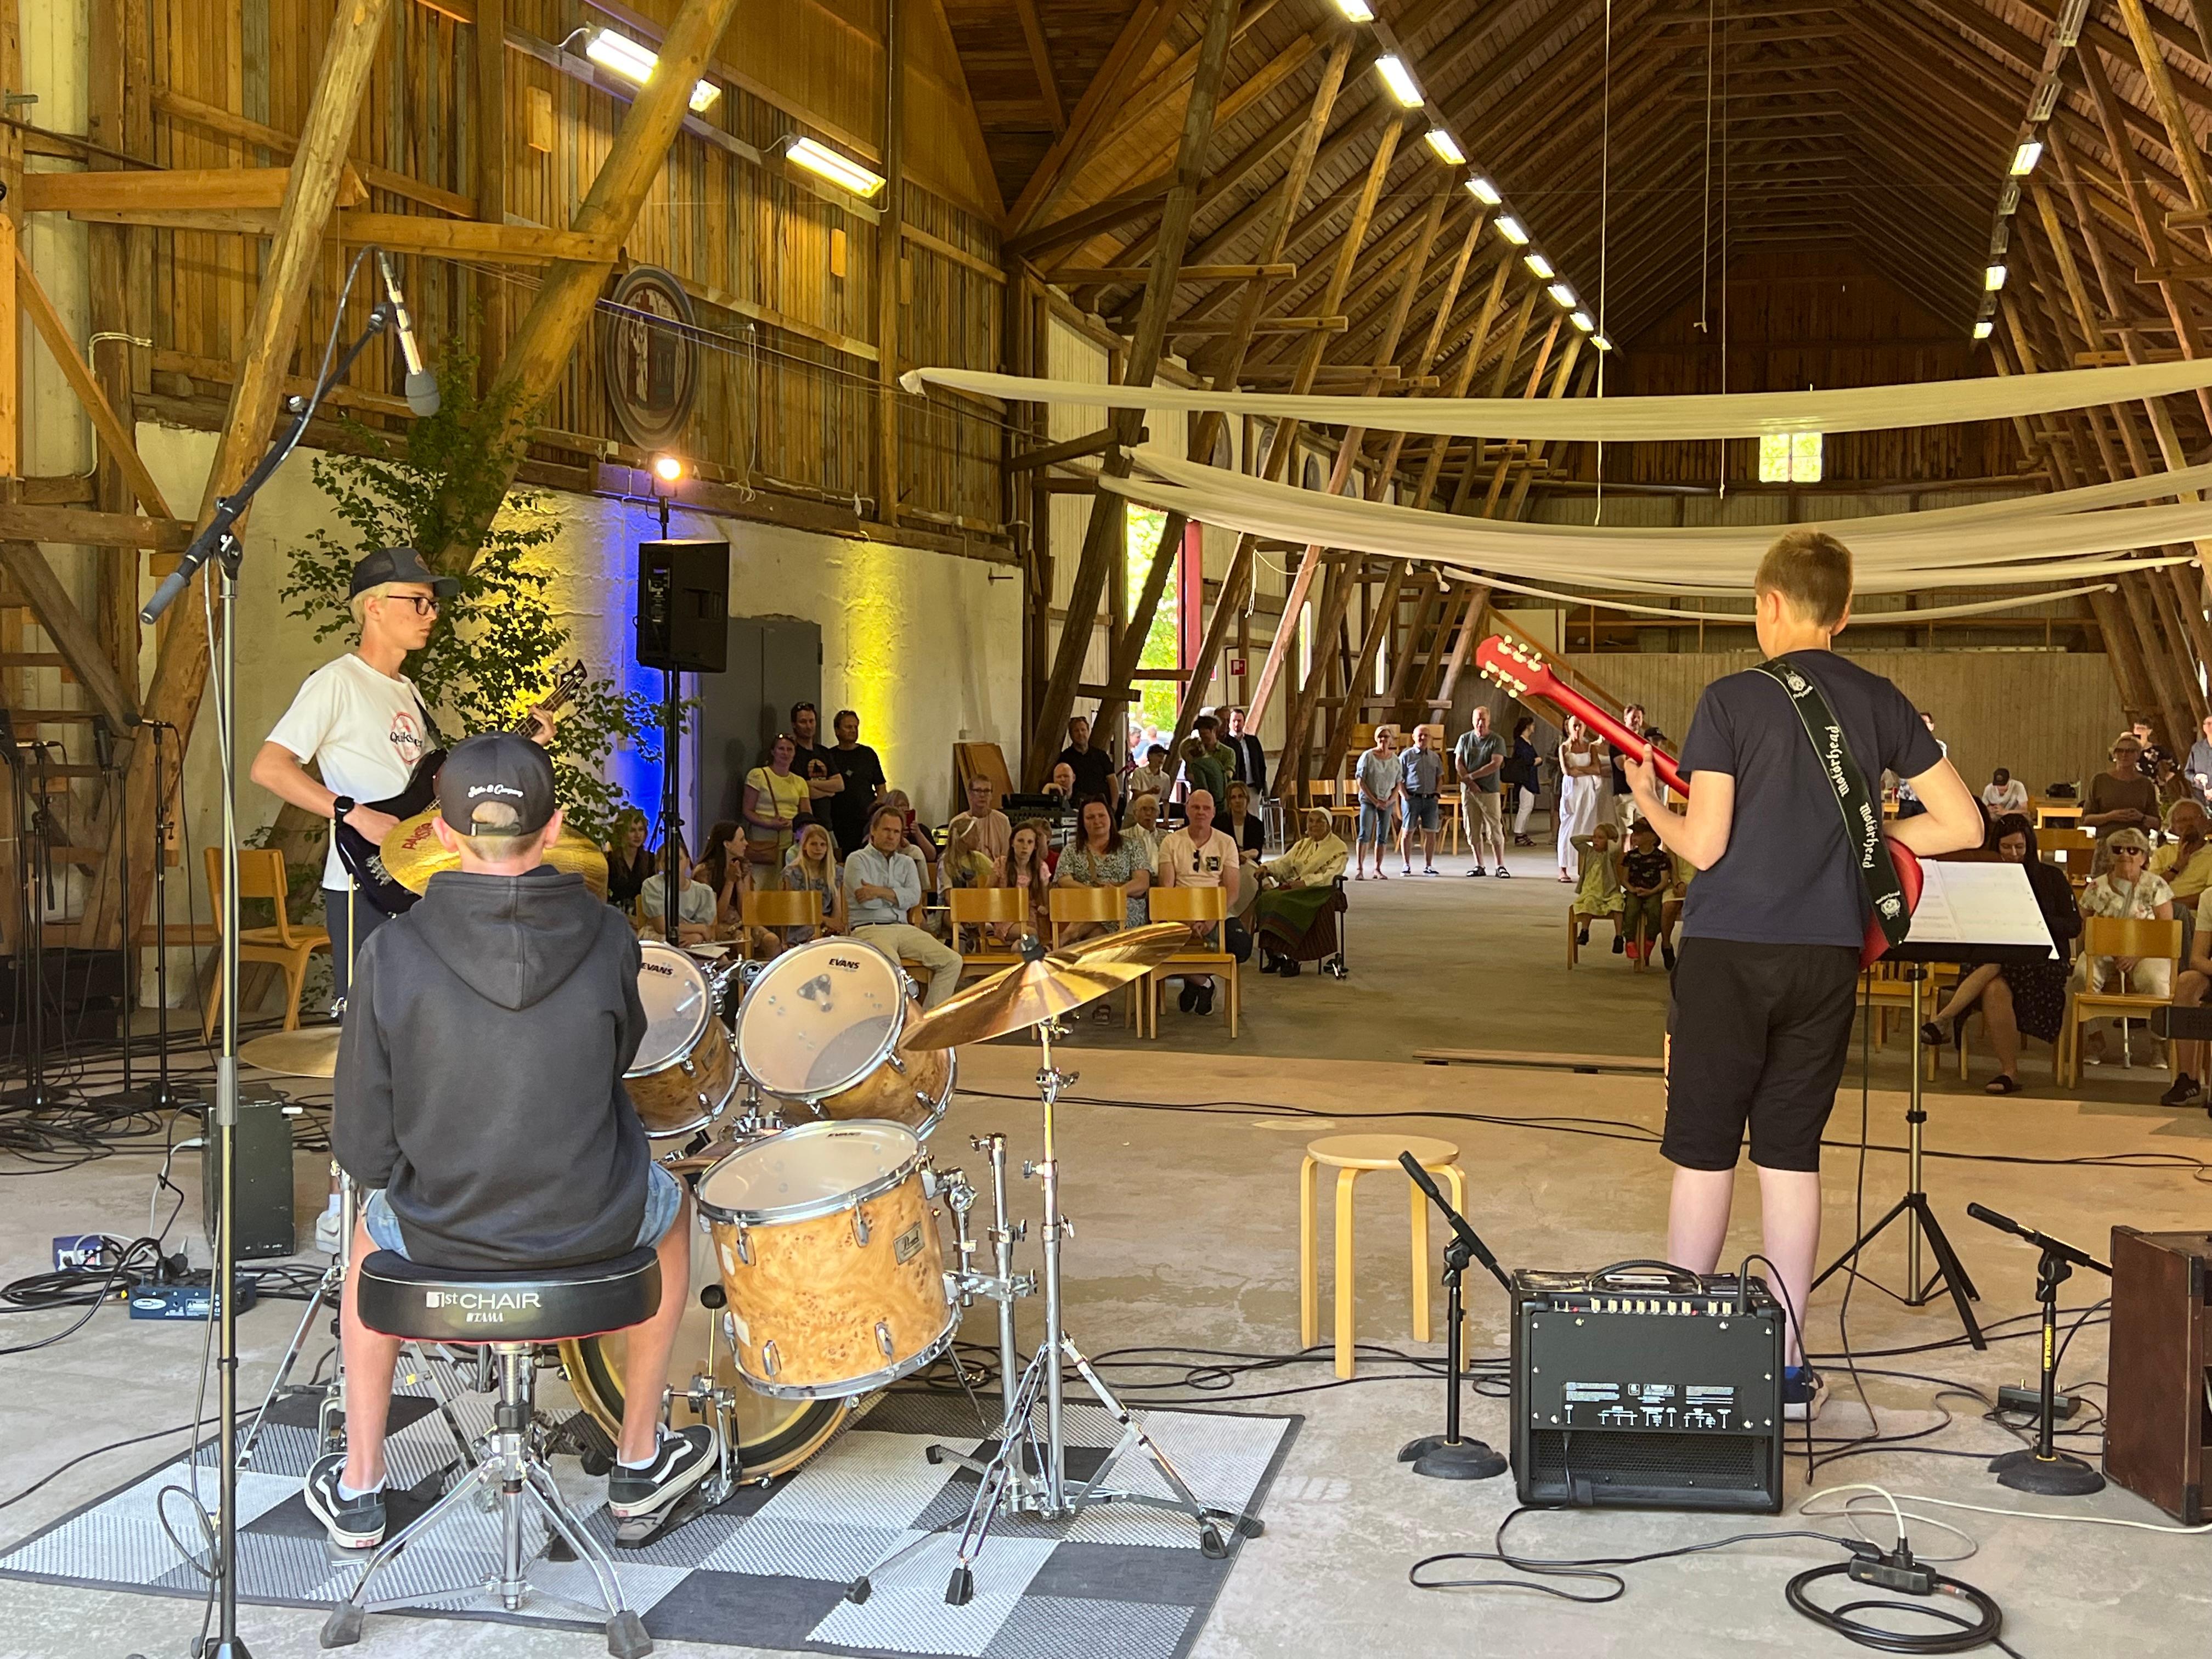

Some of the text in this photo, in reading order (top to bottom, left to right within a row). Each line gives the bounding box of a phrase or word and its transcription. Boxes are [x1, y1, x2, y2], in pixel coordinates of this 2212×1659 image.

[1825, 726, 1849, 797] Motörhead
[1860, 802, 1879, 868] Motörhead
[641, 962, 673, 975] EVANS
[829, 958, 860, 969] EVANS
[460, 1293, 541, 1310] CHAIR
[471, 1312, 504, 1323] TAMA
